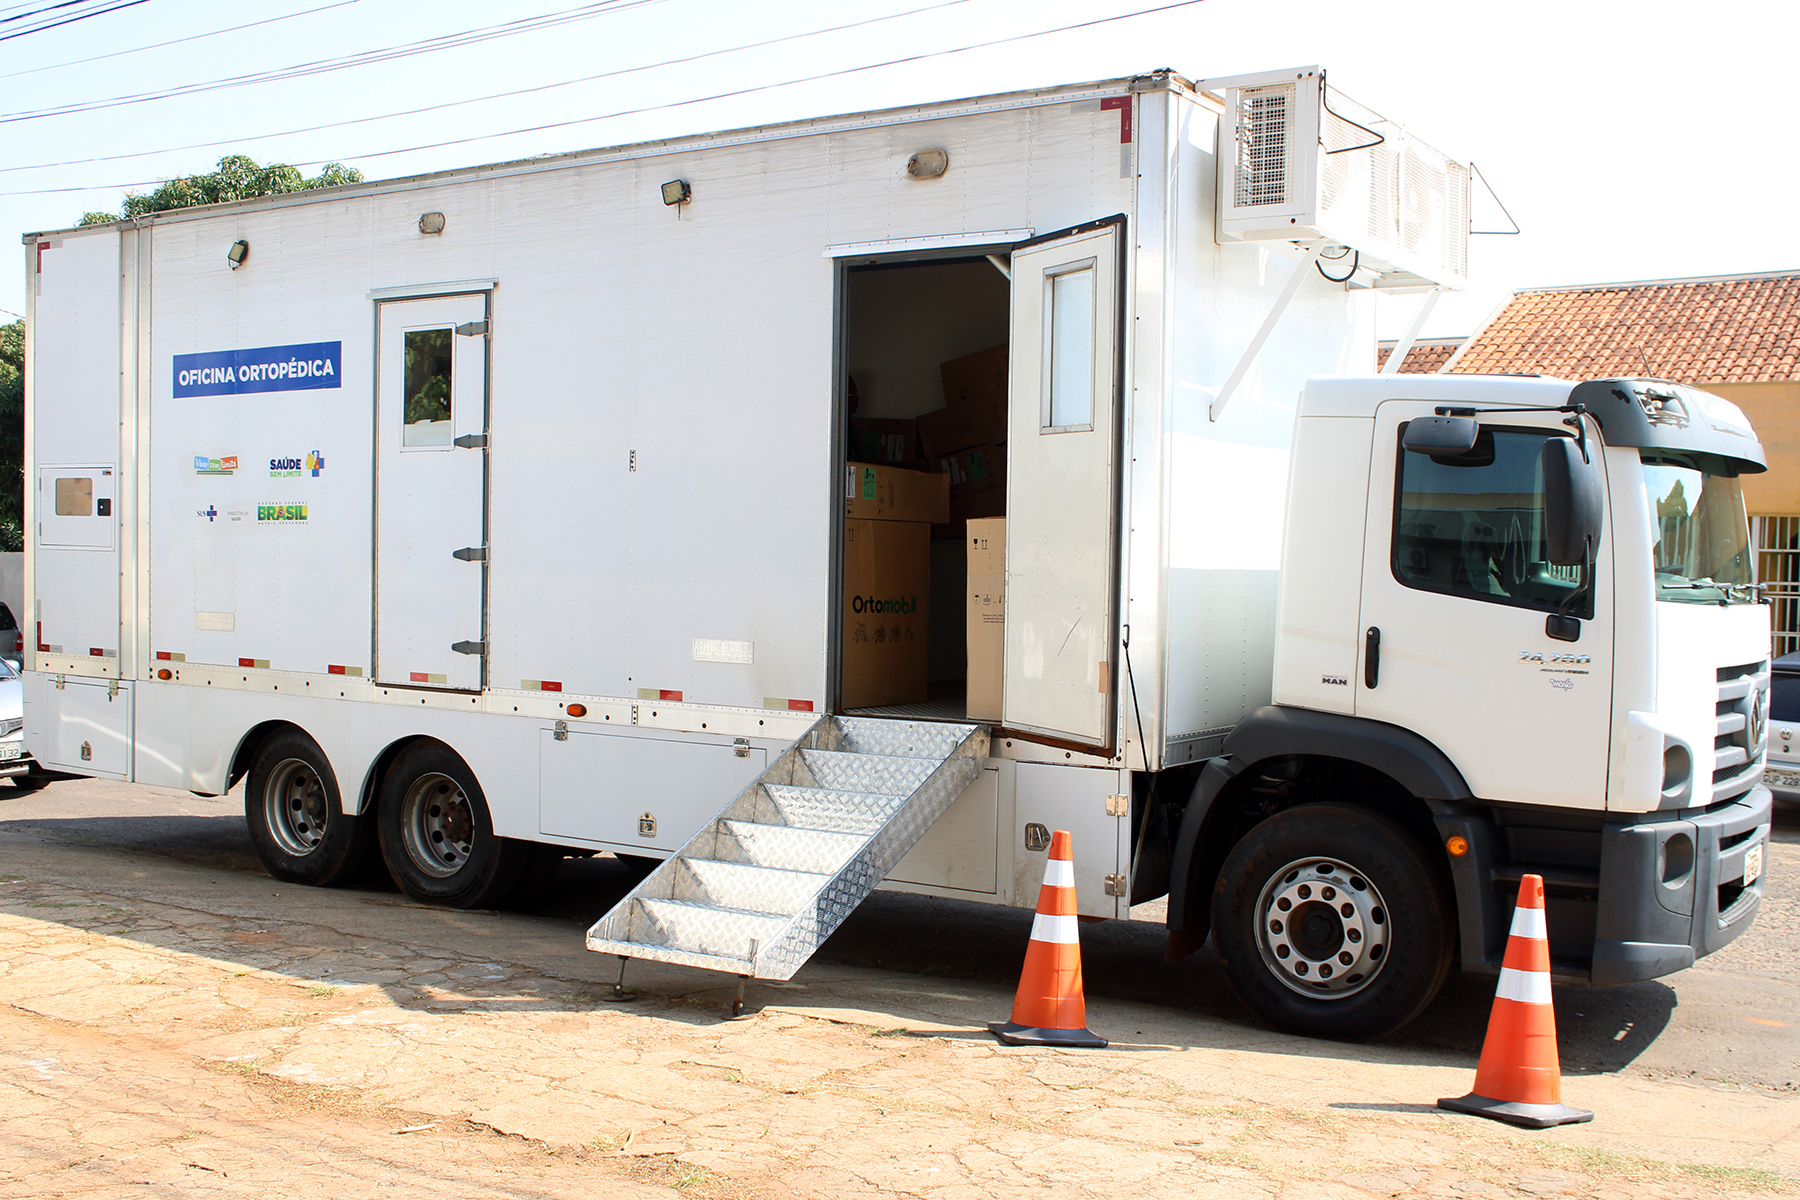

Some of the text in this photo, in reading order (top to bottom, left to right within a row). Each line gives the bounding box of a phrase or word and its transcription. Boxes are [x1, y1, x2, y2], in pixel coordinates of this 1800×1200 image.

[178, 356, 335, 387] OFICINA ORTOPÉDICA
[269, 456, 302, 470] SAÚDE
[269, 470, 302, 478] SEM LIMITE
[257, 505, 307, 521] BRASIL
[852, 594, 917, 615] Ortomobil
[1322, 677, 1347, 686] MAN
